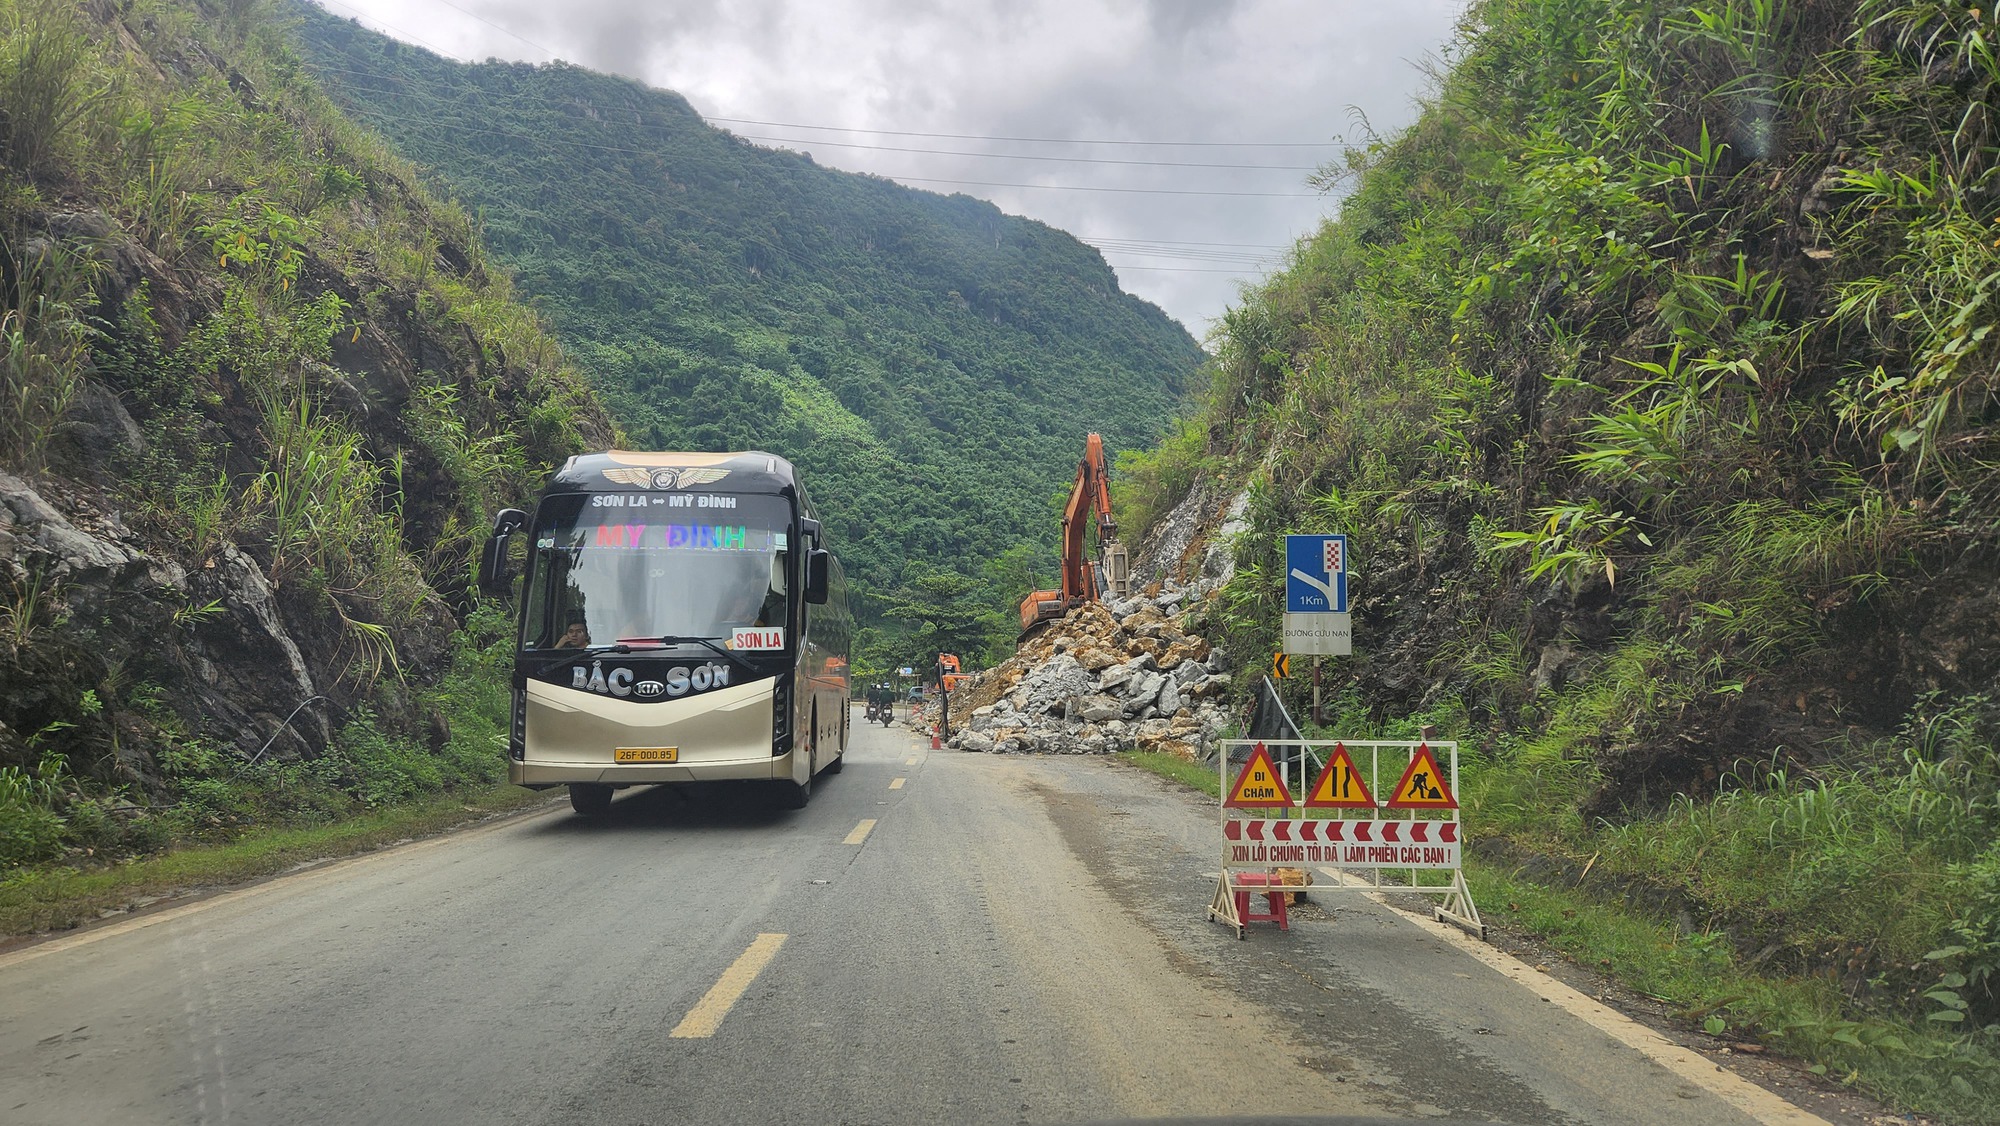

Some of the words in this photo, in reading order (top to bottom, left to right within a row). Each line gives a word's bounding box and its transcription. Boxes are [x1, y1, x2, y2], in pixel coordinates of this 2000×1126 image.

[592, 494, 624, 507] SƠN
[628, 495, 648, 507] LA
[669, 493, 695, 507] MỸ
[697, 494, 737, 508] ĐÌNH
[1300, 595, 1323, 605] 1Km
[736, 631, 762, 648] SƠN
[765, 632, 781, 648] LA
[1285, 629, 1313, 637] ĐƯỜNG
[1332, 630, 1349, 639] NẠN
[666, 661, 731, 697] SƠN
[637, 684, 660, 694] KIA
[1254, 771, 1265, 782] ĐI
[1243, 785, 1274, 800] CHẬM
[1232, 845, 1249, 862] XIN
[1252, 841, 1267, 862] LỖI
[1270, 842, 1304, 862] CHÚNG
[1306, 842, 1322, 862] TÔI
[1324, 842, 1338, 862] ĐÃ
[1344, 843, 1366, 863] LÀM
[1368, 842, 1398, 863] PHIỀN
[1401, 844, 1421, 864] CÁC
